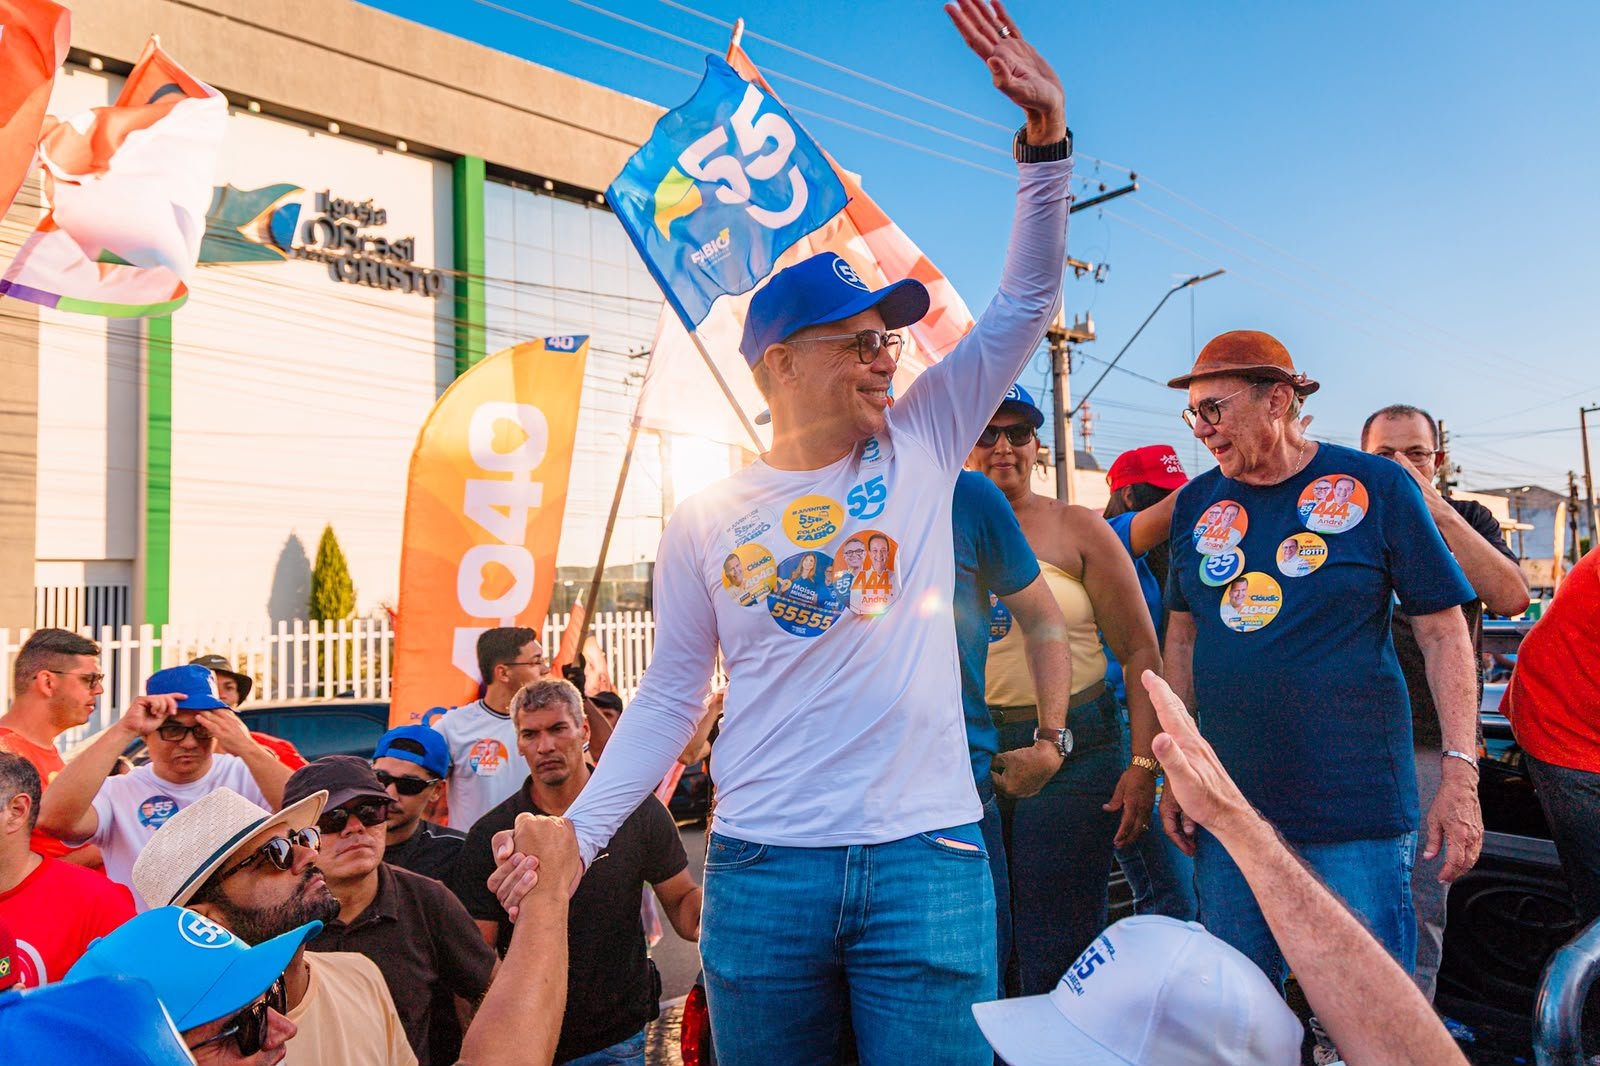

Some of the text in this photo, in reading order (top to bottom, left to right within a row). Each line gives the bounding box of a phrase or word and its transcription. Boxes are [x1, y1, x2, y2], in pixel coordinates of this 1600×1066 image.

[678, 83, 796, 205] 55
[314, 189, 387, 226] Igreja
[328, 257, 444, 297] CRISTO
[548, 336, 575, 350] 40
[847, 475, 887, 518] 55
[1312, 501, 1350, 520] 444
[1202, 525, 1231, 542] 444
[1207, 551, 1236, 570] 55
[836, 577, 851, 590] 55
[851, 570, 894, 595] 444
[771, 601, 834, 631] 55555
